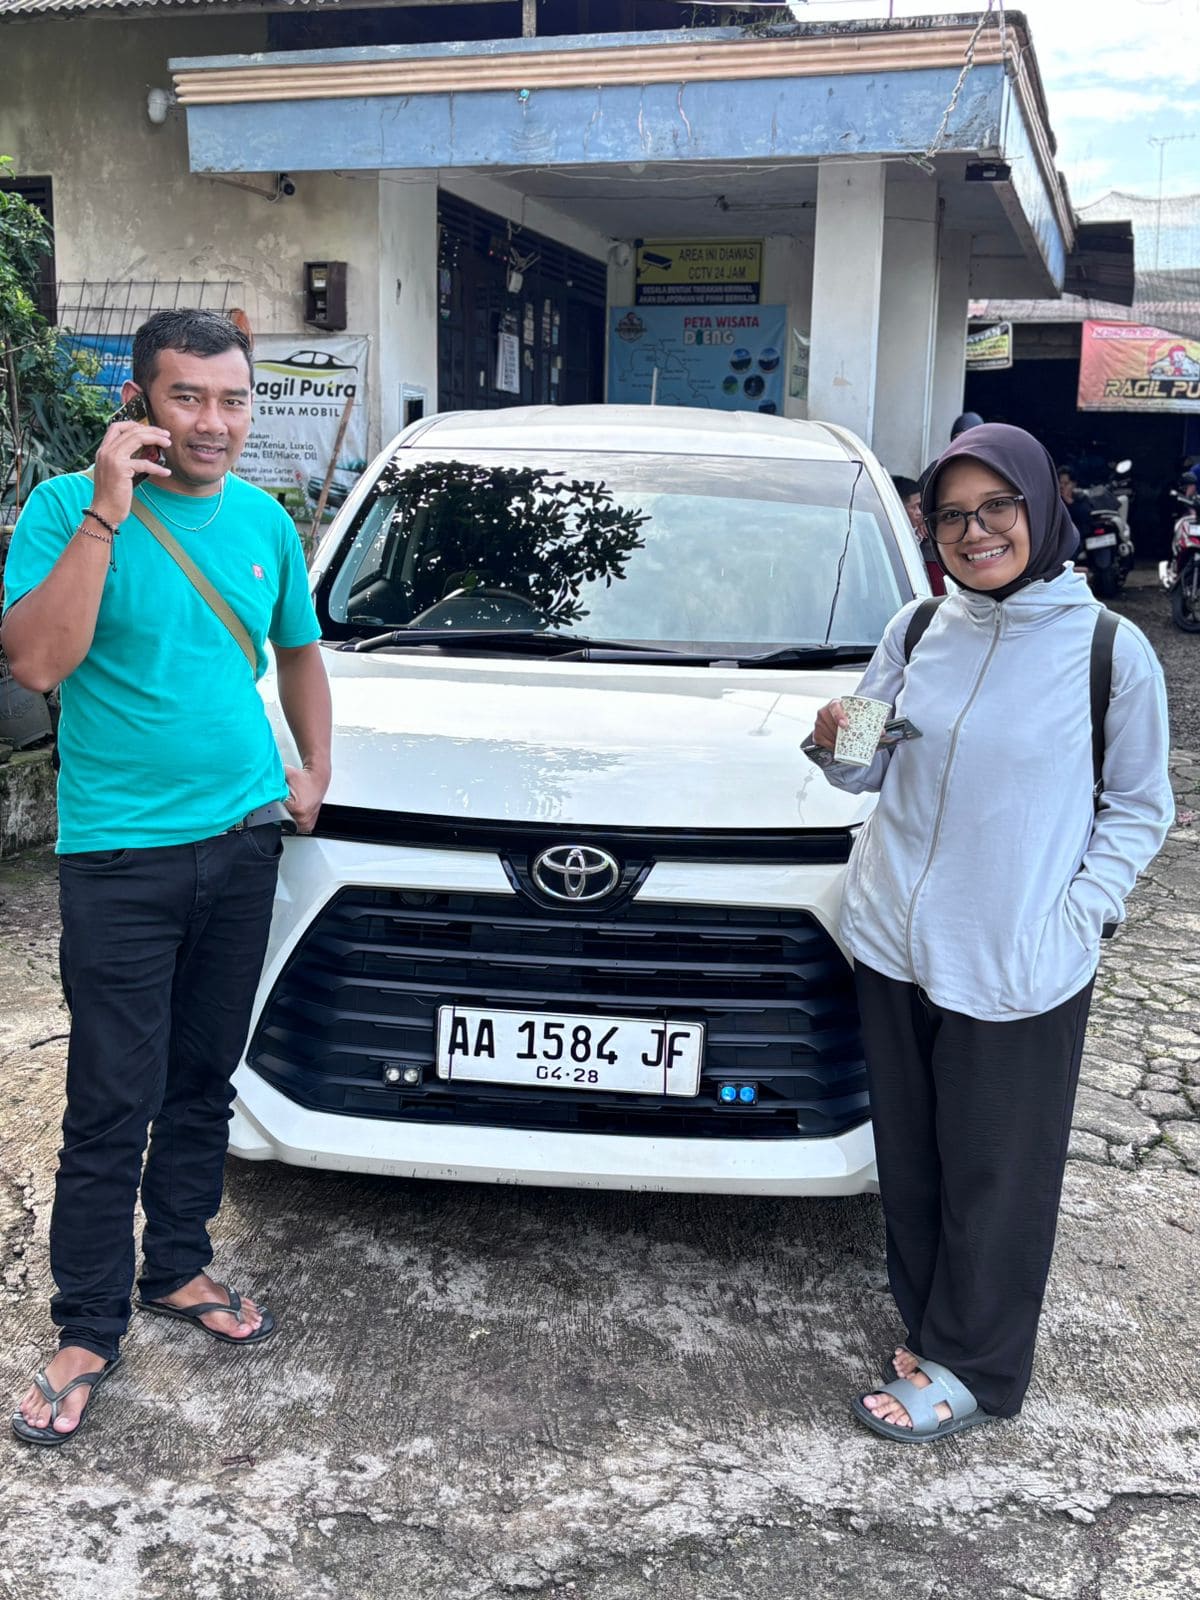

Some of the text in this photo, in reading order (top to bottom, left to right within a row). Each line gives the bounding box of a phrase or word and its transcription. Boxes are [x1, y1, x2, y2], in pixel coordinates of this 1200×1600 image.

[680, 247, 758, 261] AREA INI DIAWASI
[688, 265, 747, 280] CCTV 24 JAM
[683, 316, 759, 329] PETA WISATA
[104, 352, 133, 369] Rag
[252, 377, 357, 400] agil Putra
[1104, 380, 1168, 398] RAGIL
[260, 406, 340, 417] SEWA MOBIL
[244, 441, 287, 450] nza/Xenia,
[448, 1016, 691, 1069] AA 1584 JF
